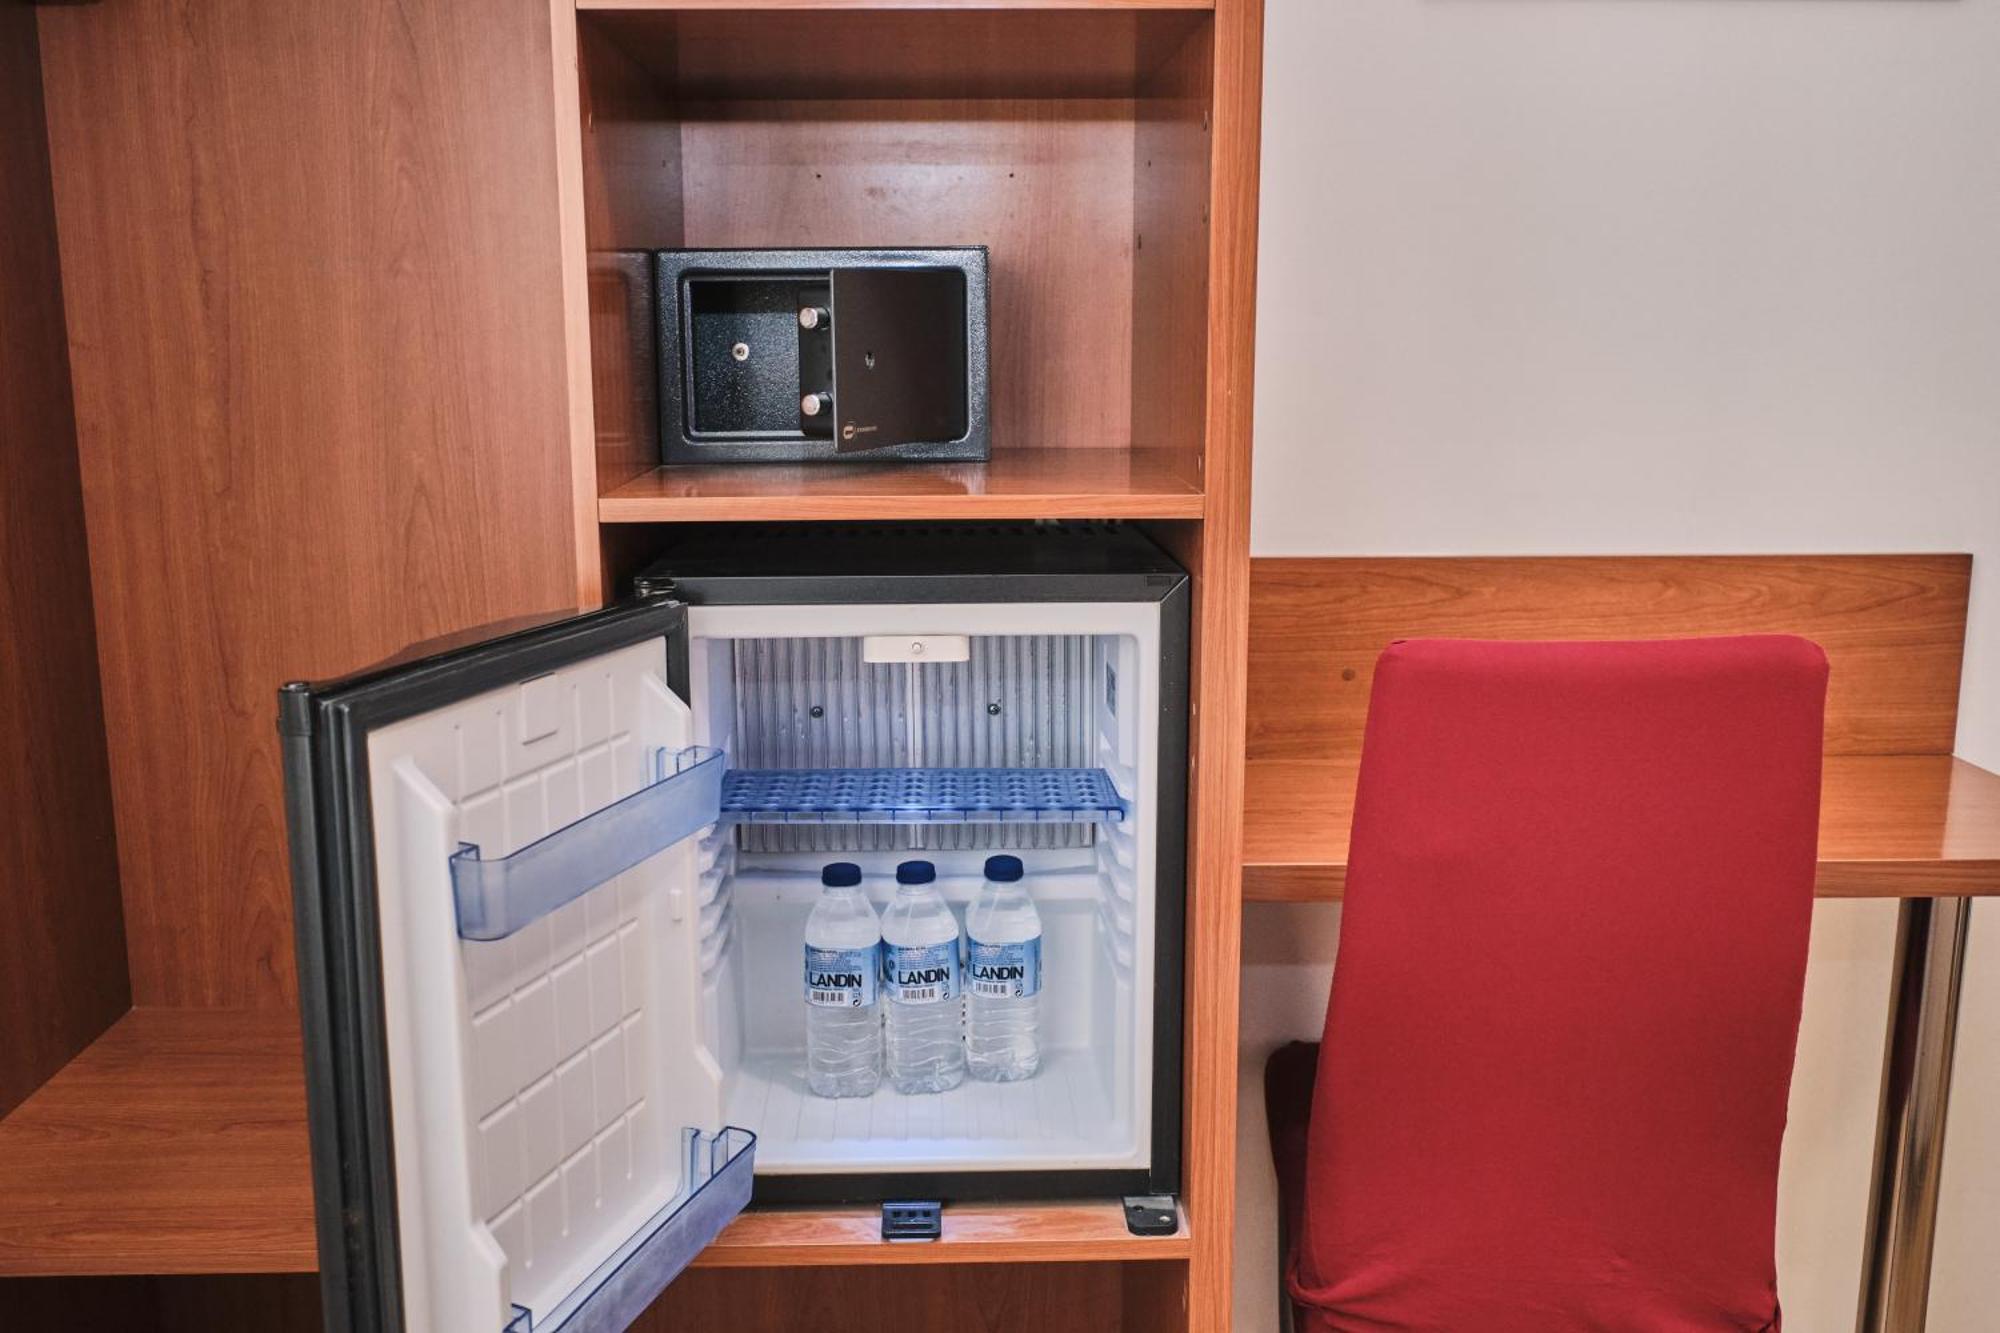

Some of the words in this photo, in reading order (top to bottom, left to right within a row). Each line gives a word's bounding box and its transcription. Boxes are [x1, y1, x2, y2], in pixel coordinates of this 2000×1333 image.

[809, 971, 863, 988] LANDIN
[898, 967, 950, 985] LANDIN
[972, 965, 1024, 981] LANDIN
